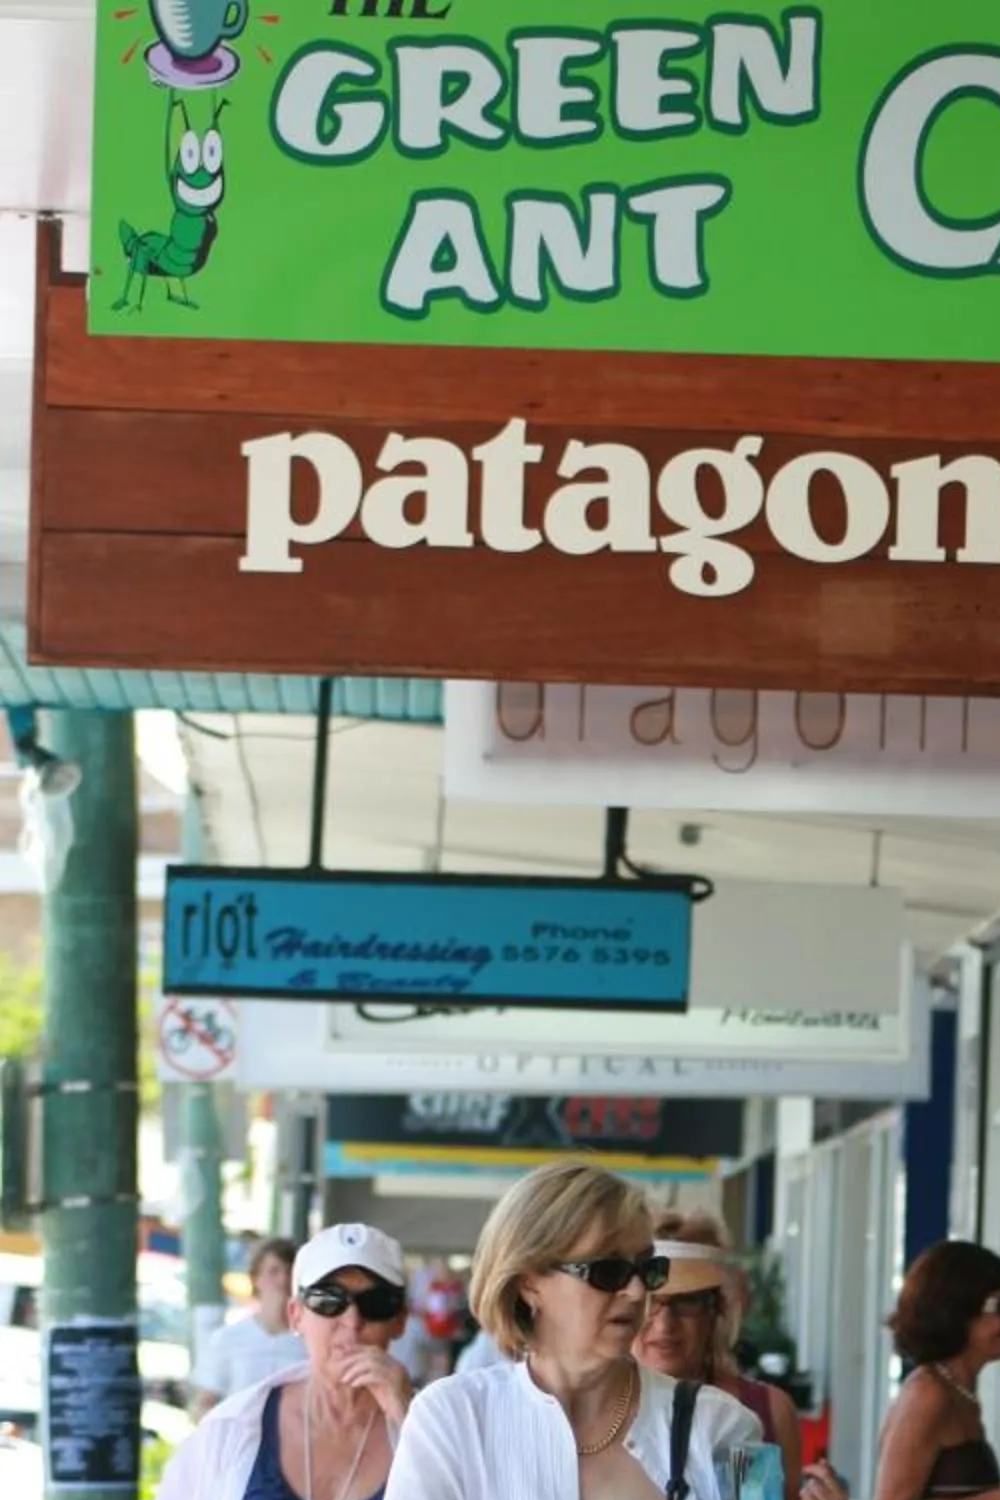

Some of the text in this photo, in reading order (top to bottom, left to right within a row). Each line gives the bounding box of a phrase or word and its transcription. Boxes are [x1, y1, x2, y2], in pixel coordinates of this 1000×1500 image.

[272, 10, 820, 162] GREEN
[382, 177, 730, 316] ANT
[264, 926, 492, 974] Hairdressing
[530, 921, 633, 941] Phone
[476, 1053, 691, 1077] OPTICAL
